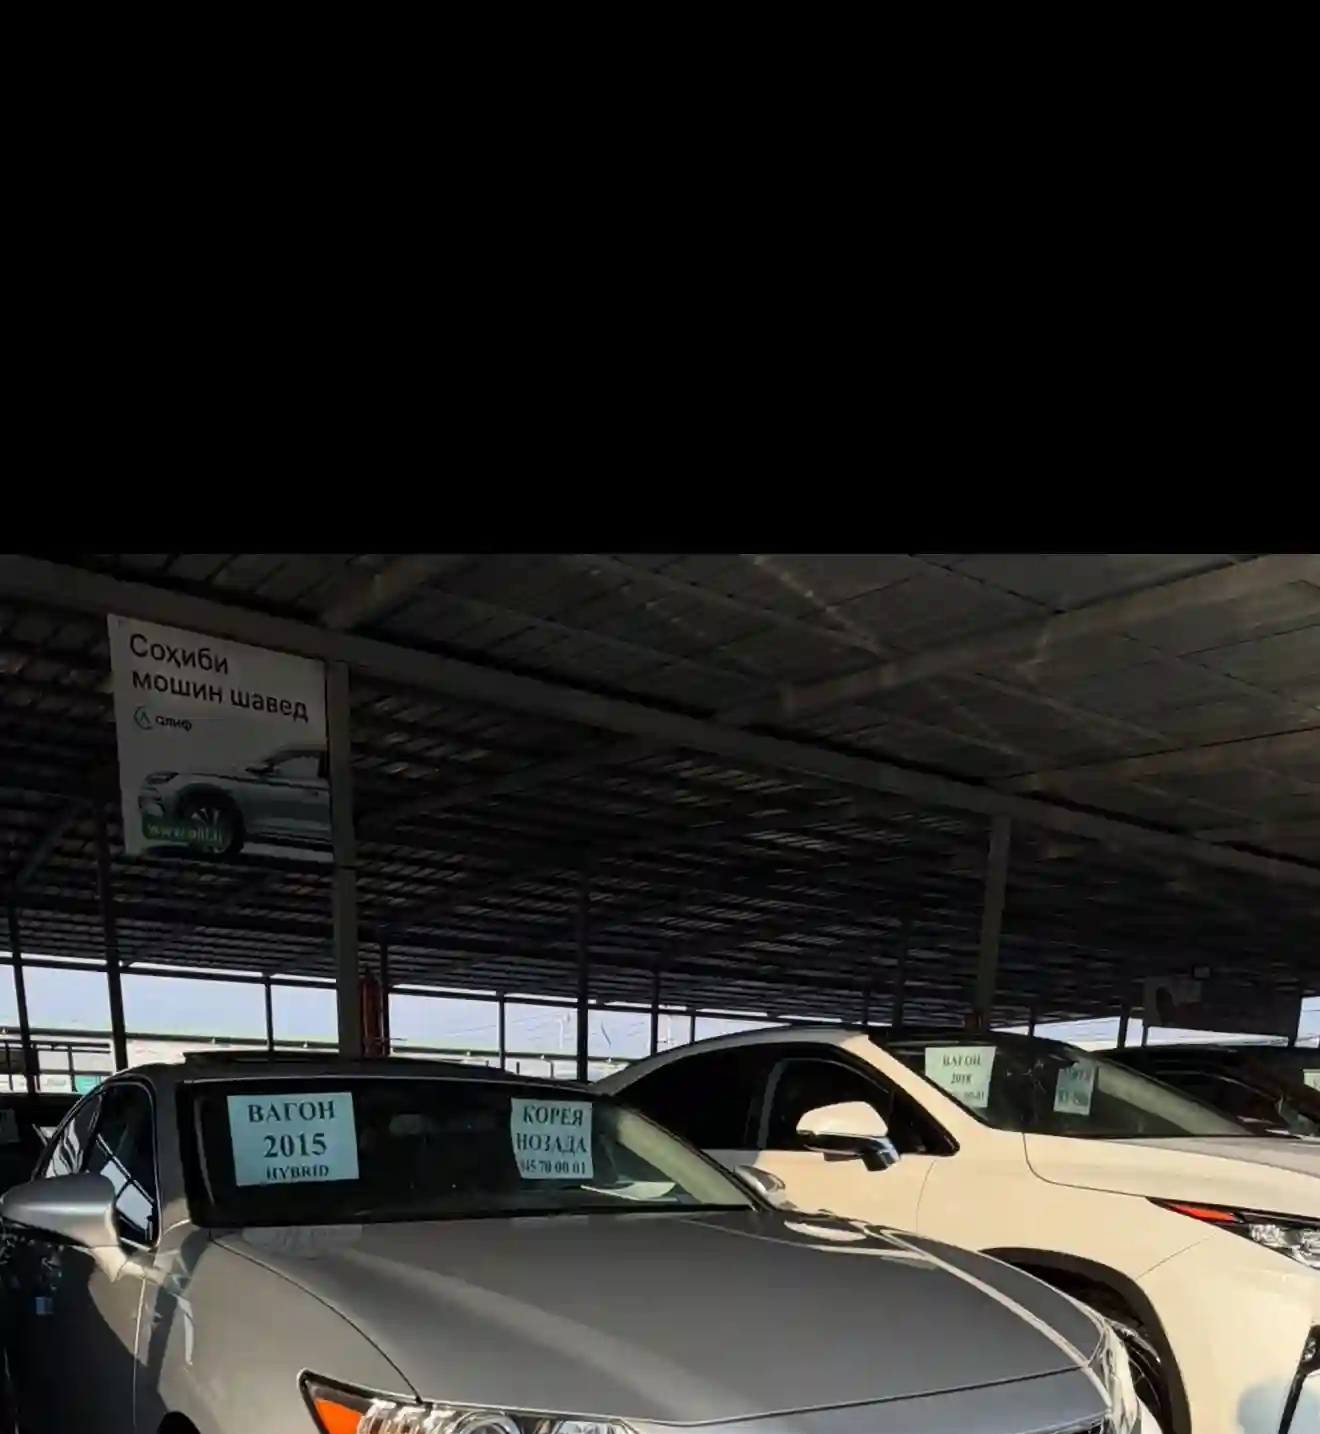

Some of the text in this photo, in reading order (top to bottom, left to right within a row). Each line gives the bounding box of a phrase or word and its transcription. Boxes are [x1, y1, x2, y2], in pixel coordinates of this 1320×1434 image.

[129, 633, 229, 675] Соҳиби
[132, 670, 309, 723] мошин шавед
[247, 1100, 336, 1123] ВАГОН
[523, 1105, 584, 1127] КОРЕЯ
[263, 1132, 327, 1158] 2015
[516, 1132, 587, 1156] НОЗАДА
[266, 1165, 330, 1180] HYBRID
